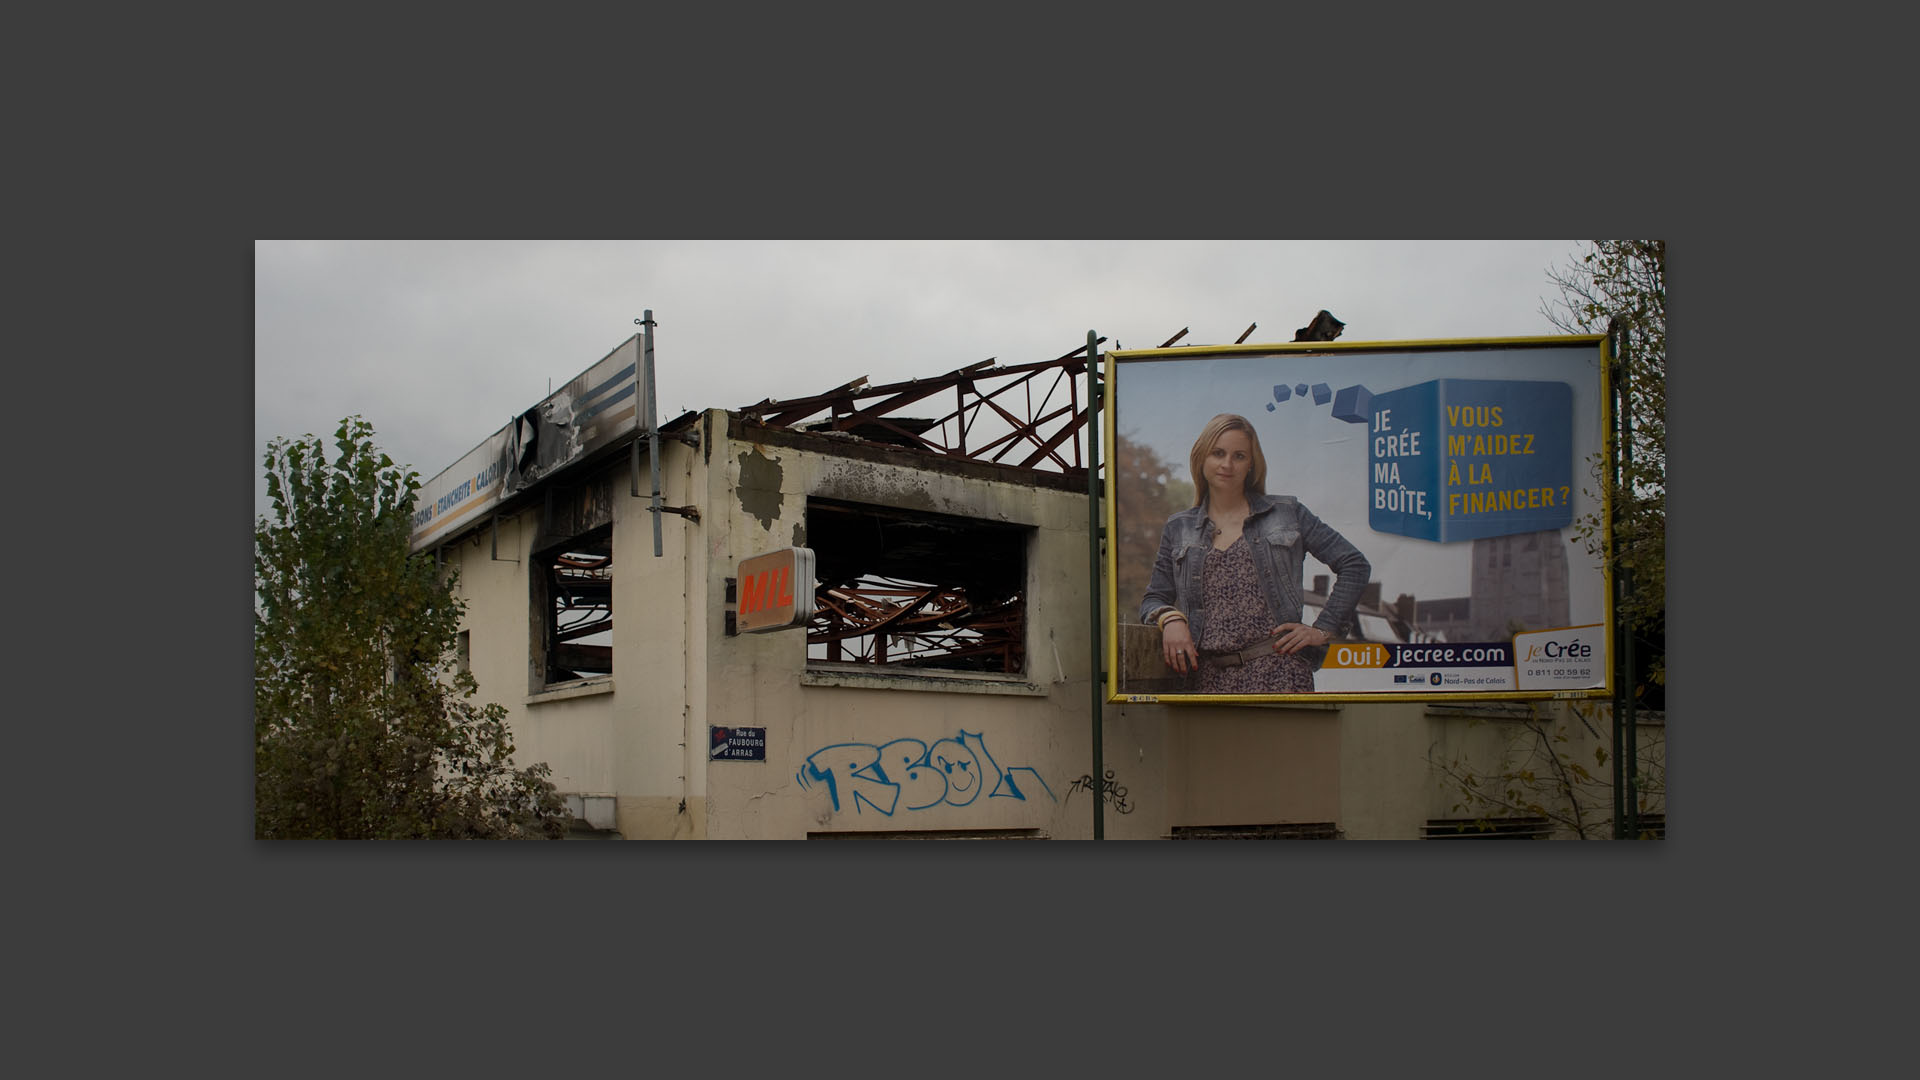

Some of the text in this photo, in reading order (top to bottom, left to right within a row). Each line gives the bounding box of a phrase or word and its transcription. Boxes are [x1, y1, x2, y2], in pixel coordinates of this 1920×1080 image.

[1373, 409, 1391, 432] JE
[1447, 405, 1504, 427] VOUS
[1374, 428, 1421, 458] CRÉE
[1448, 434, 1535, 456] M'AIDEZ
[1374, 462, 1400, 484] MA
[1448, 459, 1493, 486] À LA
[1375, 485, 1432, 520] BOÎTE,
[1449, 486, 1570, 516] FINANCER ?
[739, 566, 793, 615] MIL
[1337, 647, 1371, 665] Oui
[1393, 646, 1505, 667] jecree.com
[1544, 638, 1591, 658] Crée
[1486, 676, 1506, 684] Calais
[728, 738, 764, 747] FAUBOURG
[736, 729, 747, 737] Rue
[724, 749, 753, 757] d'ARRAS
